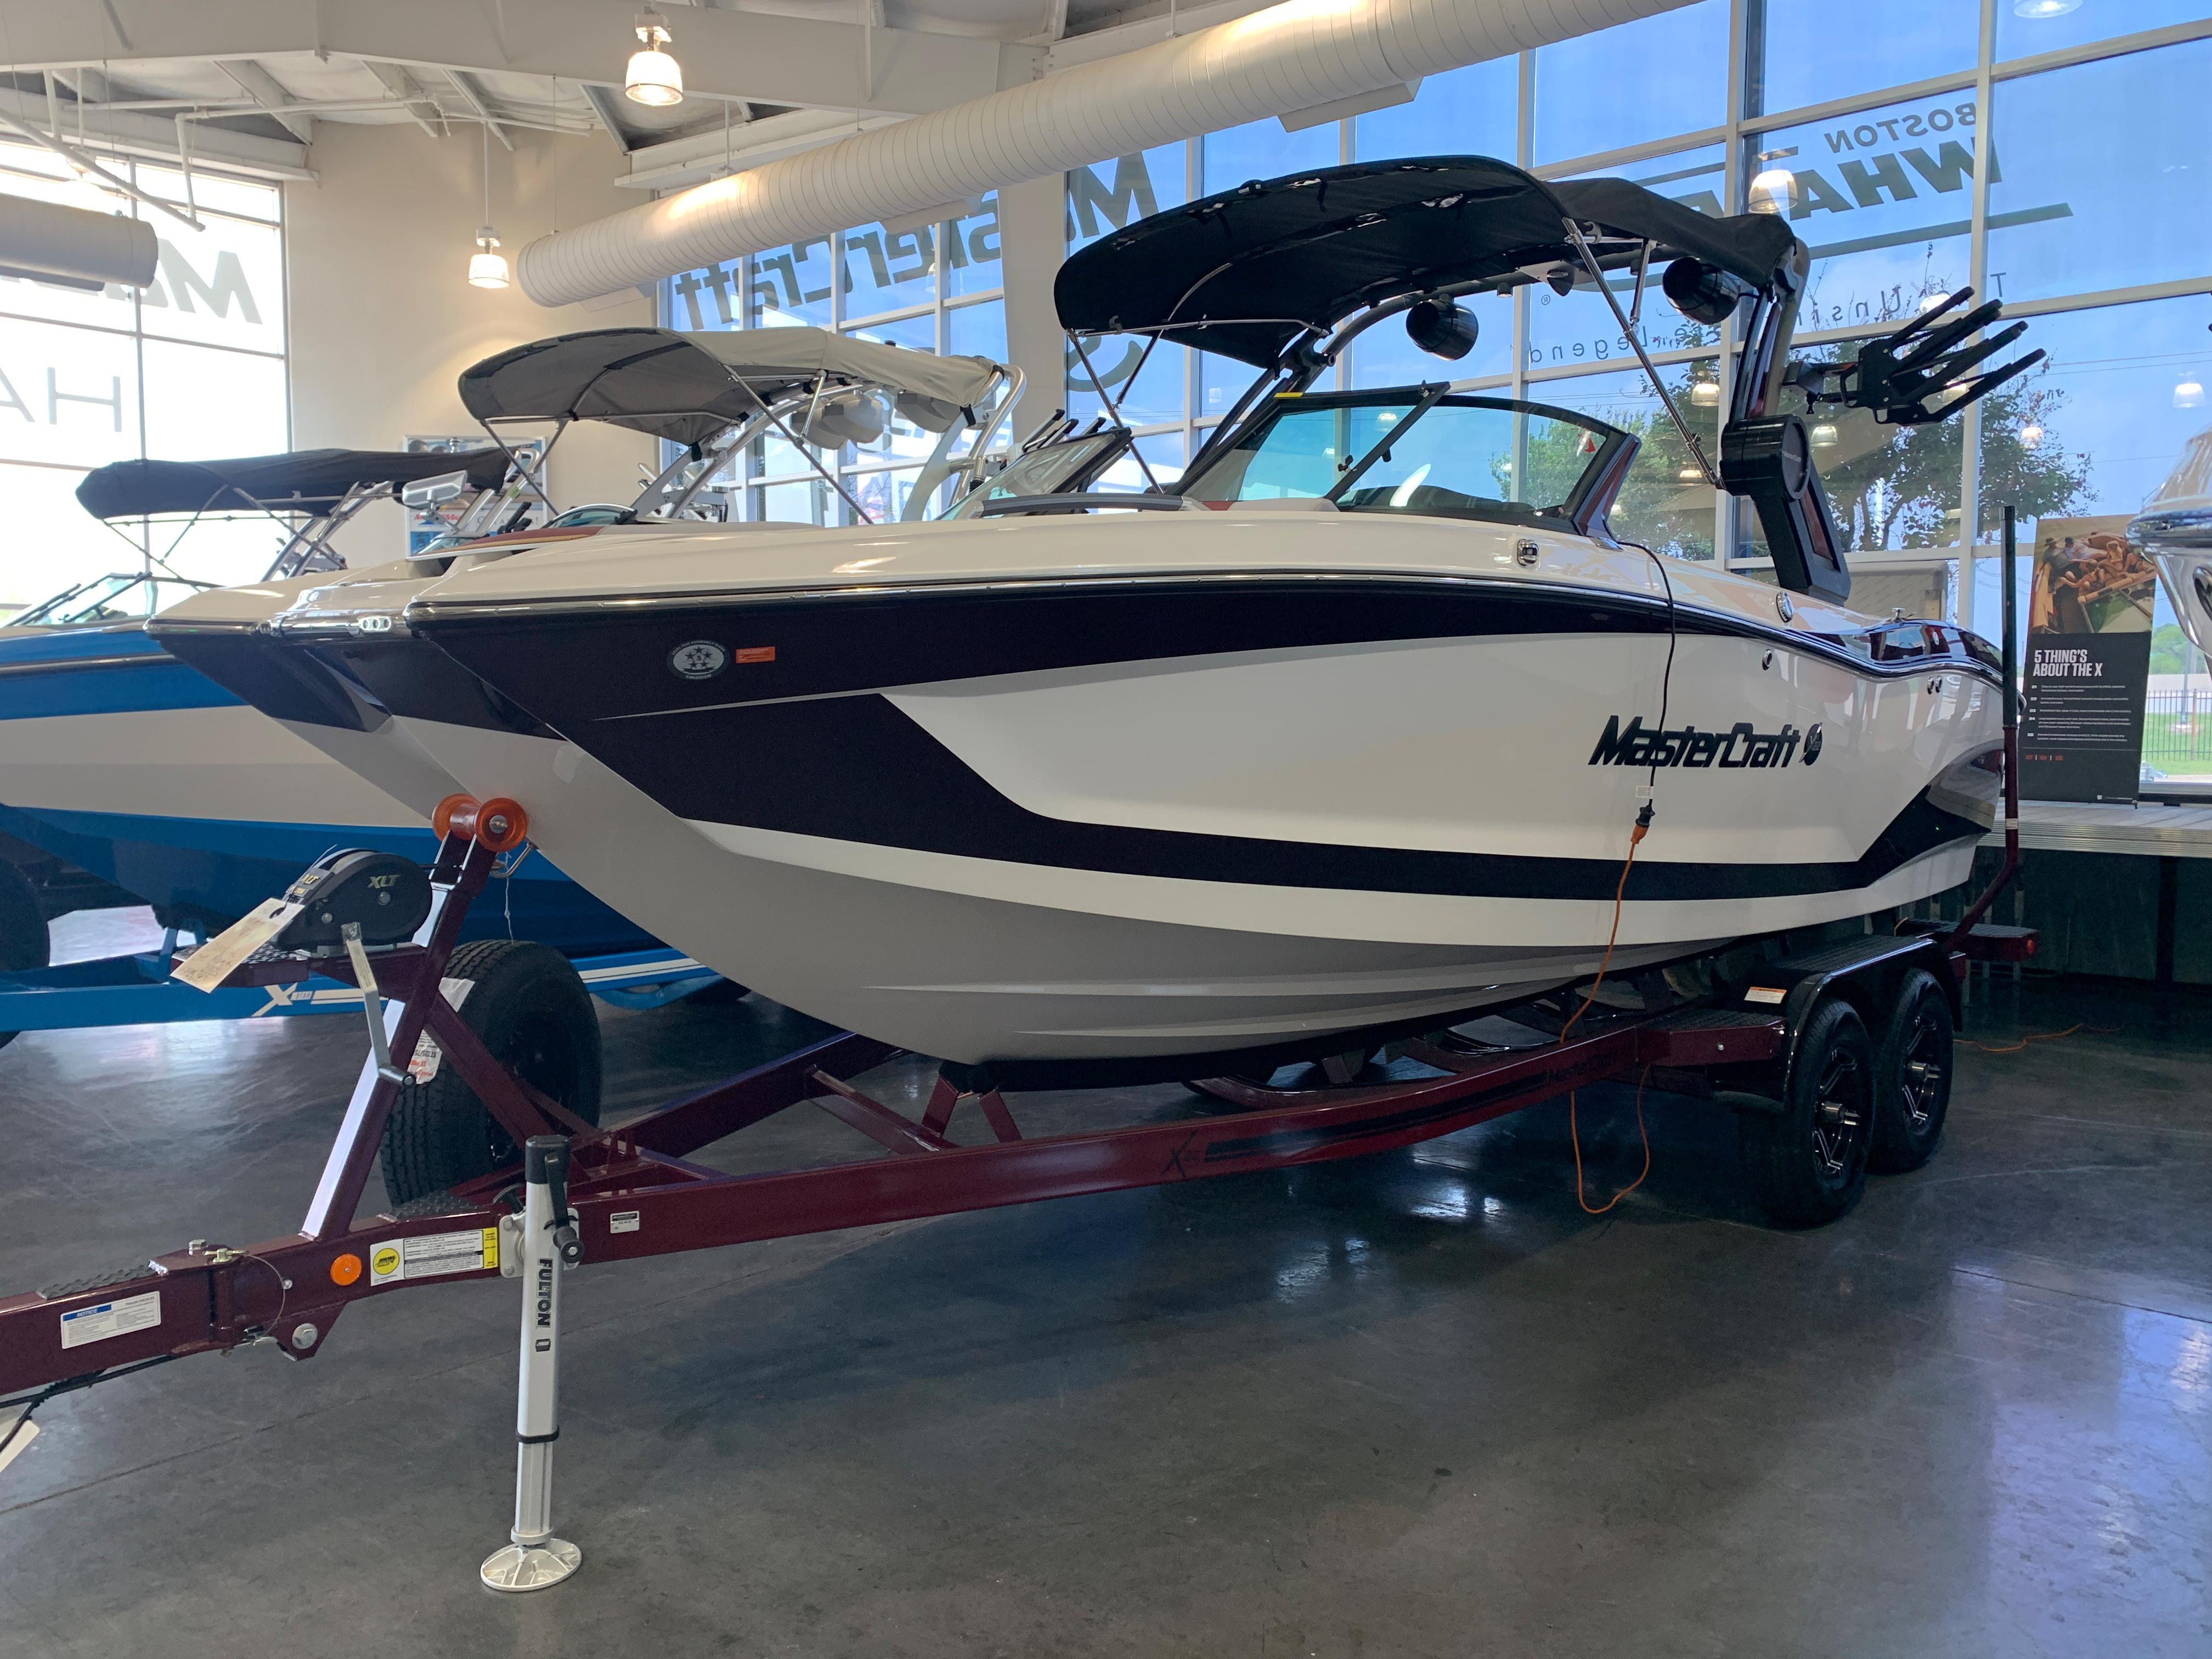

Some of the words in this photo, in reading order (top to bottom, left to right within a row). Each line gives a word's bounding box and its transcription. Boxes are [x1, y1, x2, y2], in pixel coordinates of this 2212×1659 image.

[2034, 650, 2042, 663] 5
[2044, 649, 2088, 663] THING'S
[2033, 663, 2070, 676] ABOUT
[2072, 663, 2093, 676] THE
[2094, 663, 2103, 676] X
[1588, 715, 1801, 768] MasterCraft
[367, 874, 400, 889] XLT
[536, 1258, 552, 1328] FULTON
[77, 1308, 98, 1317] NOTICE
